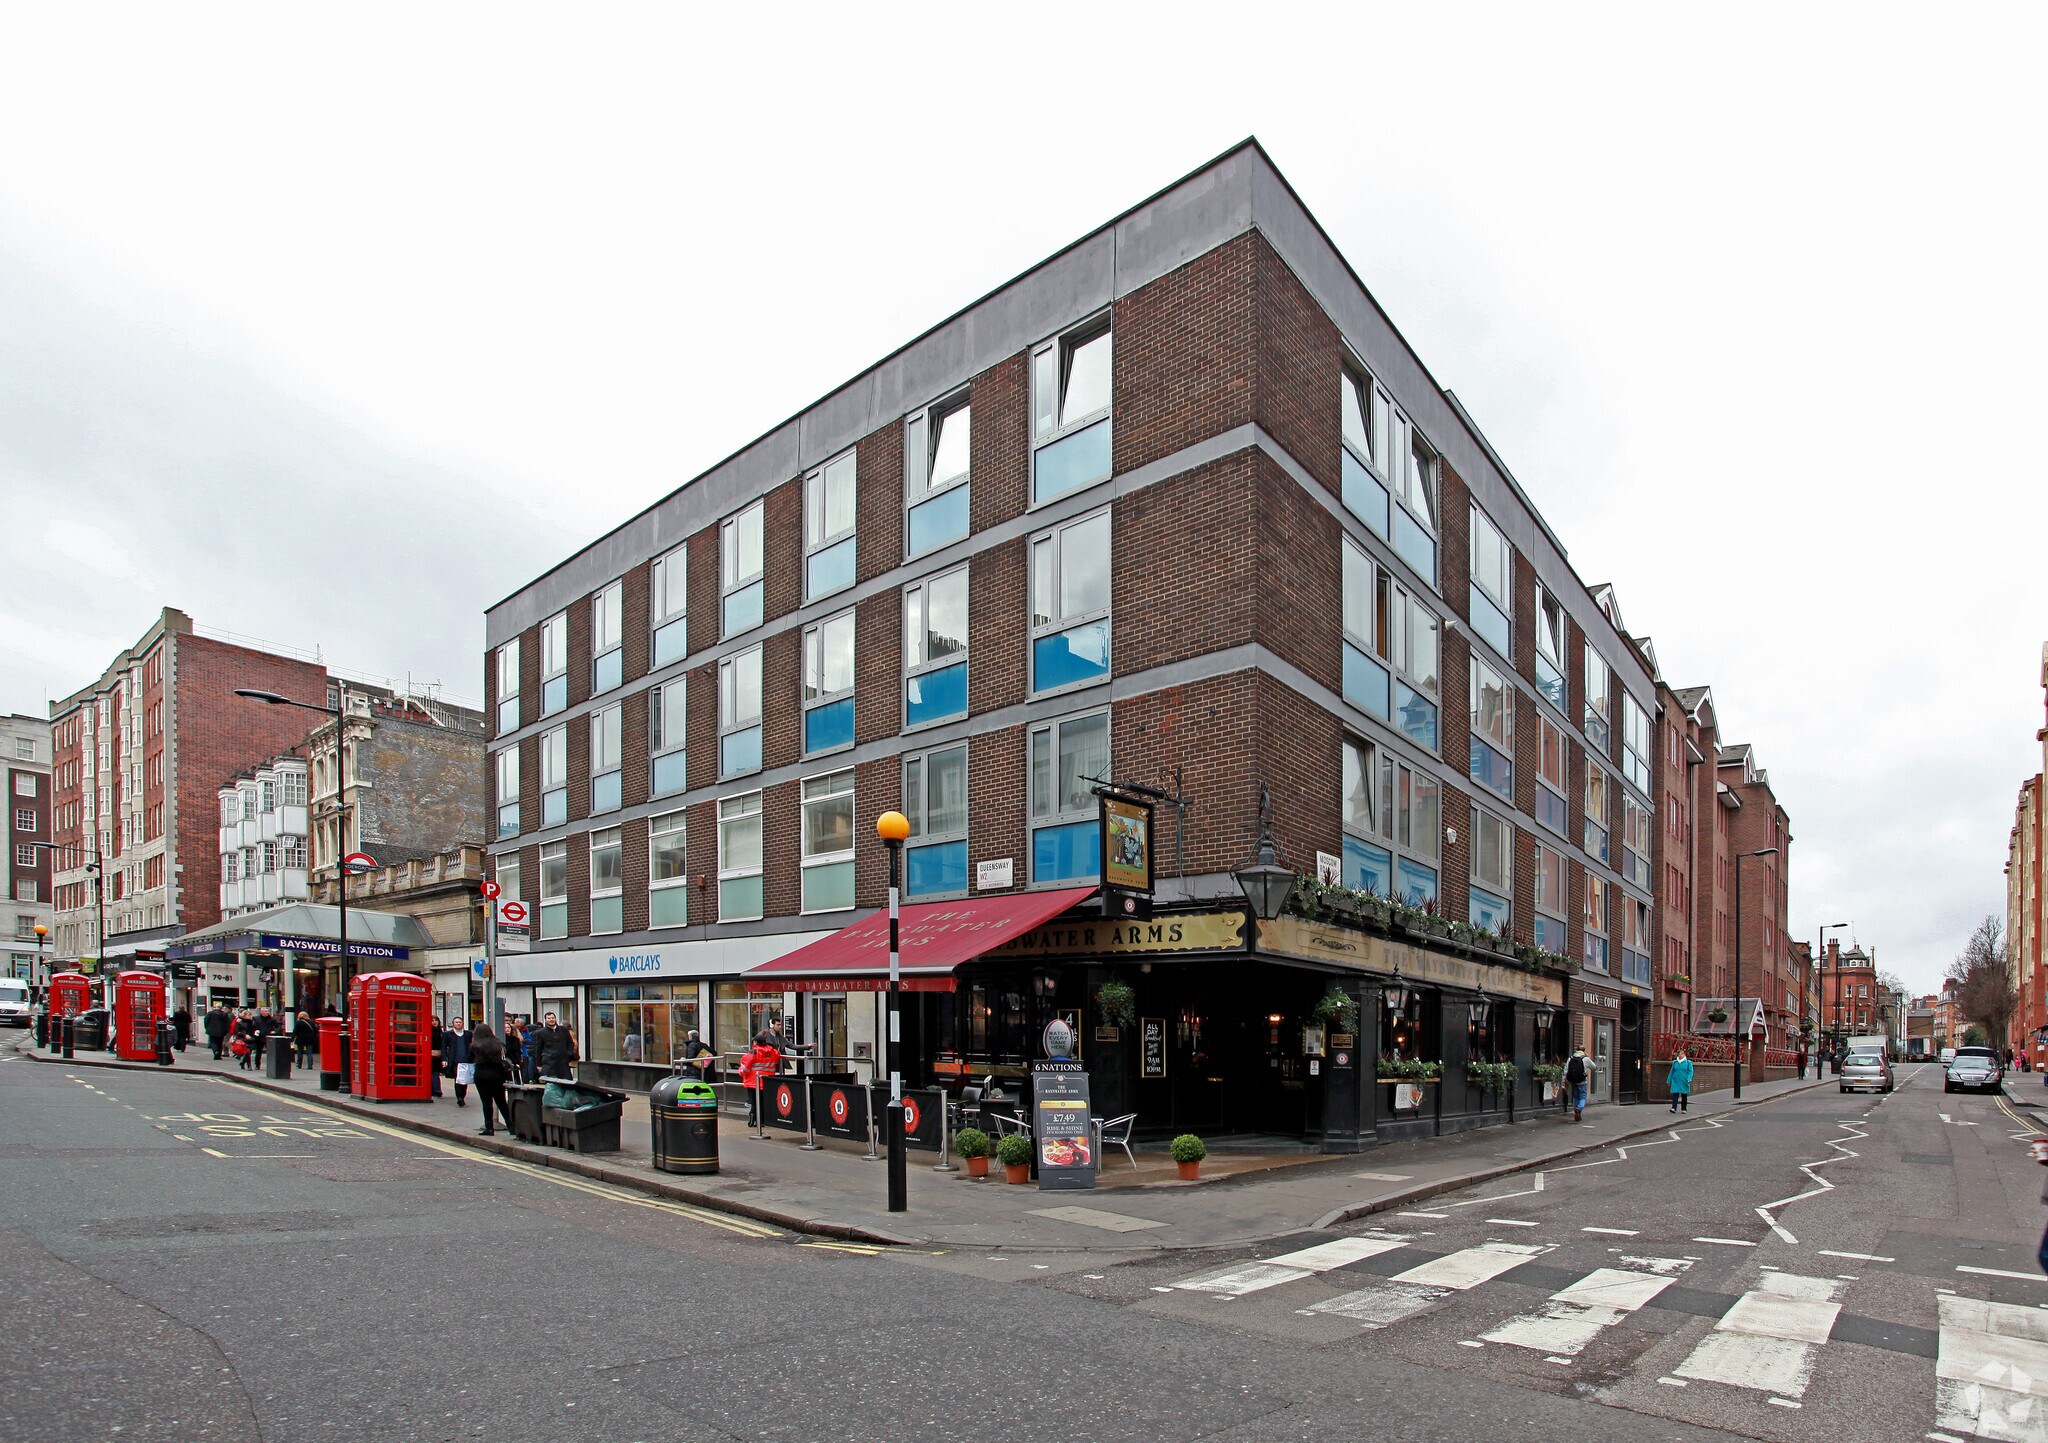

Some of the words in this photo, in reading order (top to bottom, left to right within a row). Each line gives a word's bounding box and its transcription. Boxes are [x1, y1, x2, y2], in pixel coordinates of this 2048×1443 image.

[980, 861, 1009, 871] QUEENSWAY
[486, 883, 497, 896] P
[921, 910, 977, 922] THE
[997, 929, 1095, 950] SWATER
[1111, 923, 1183, 945] ARMS
[349, 945, 393, 956] STATION
[619, 954, 660, 972] BARCLAYS
[212, 974, 233, 982] 79-81
[388, 984, 423, 992] TELEPHONE
[781, 982, 799, 990] THE
[805, 981, 870, 990] BAYSWATER
[876, 980, 909, 990] ARS
[1604, 996, 1618, 1008] COURT
[1065, 1012, 1073, 1026] 4
[1042, 1064, 1082, 1072] NATIONS
[1053, 1114, 1076, 1122] £7.49
[200, 1125, 375, 1140] BUS
